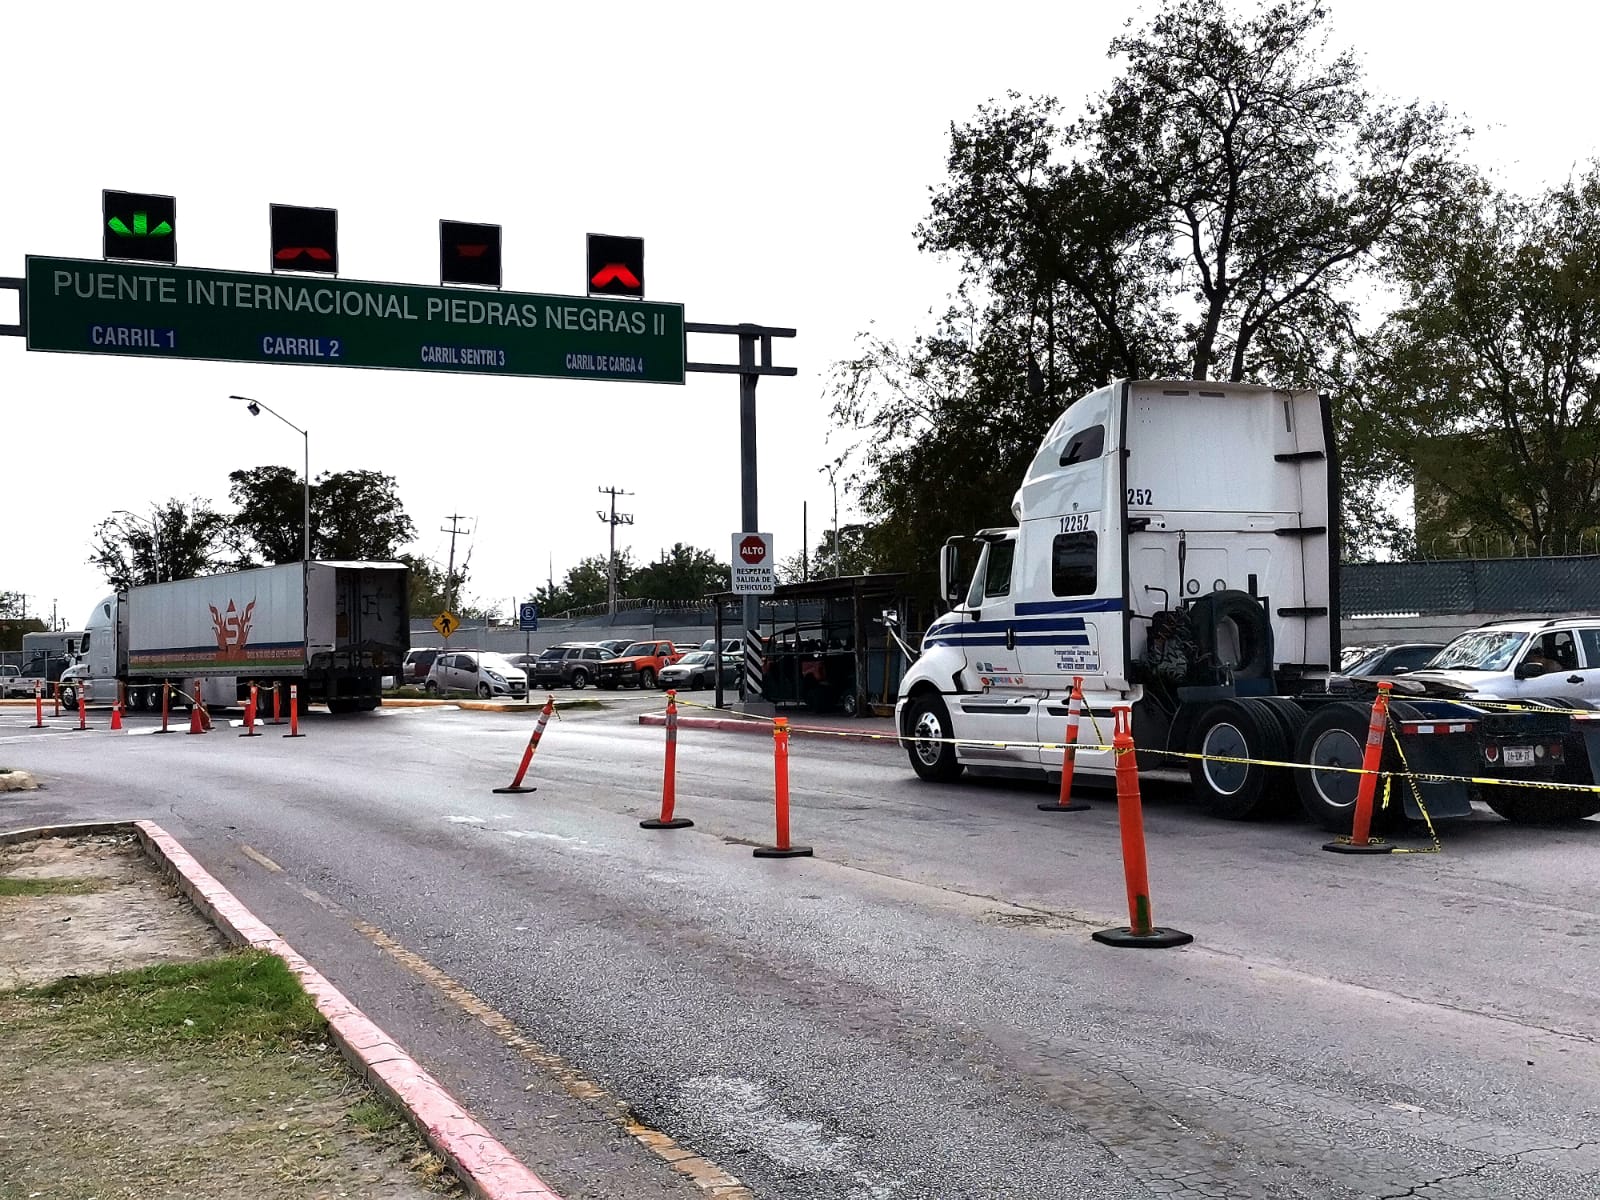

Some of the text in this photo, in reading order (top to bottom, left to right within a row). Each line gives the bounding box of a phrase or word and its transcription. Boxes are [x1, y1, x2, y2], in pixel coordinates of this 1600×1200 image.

[54, 270, 665, 336] PUENTE INTERNACIONAL PIEDRAS NEGRAS II
[92, 325, 176, 349] CARRIL 1
[263, 336, 340, 358] CARRIL 2
[421, 345, 505, 367] CARRIL SENTRI 3
[566, 353, 643, 374] CARRIL DE CARGA 4
[1059, 513, 1090, 533] 12252
[741, 546, 764, 555] ALTO
[526, 608, 531, 618] E
